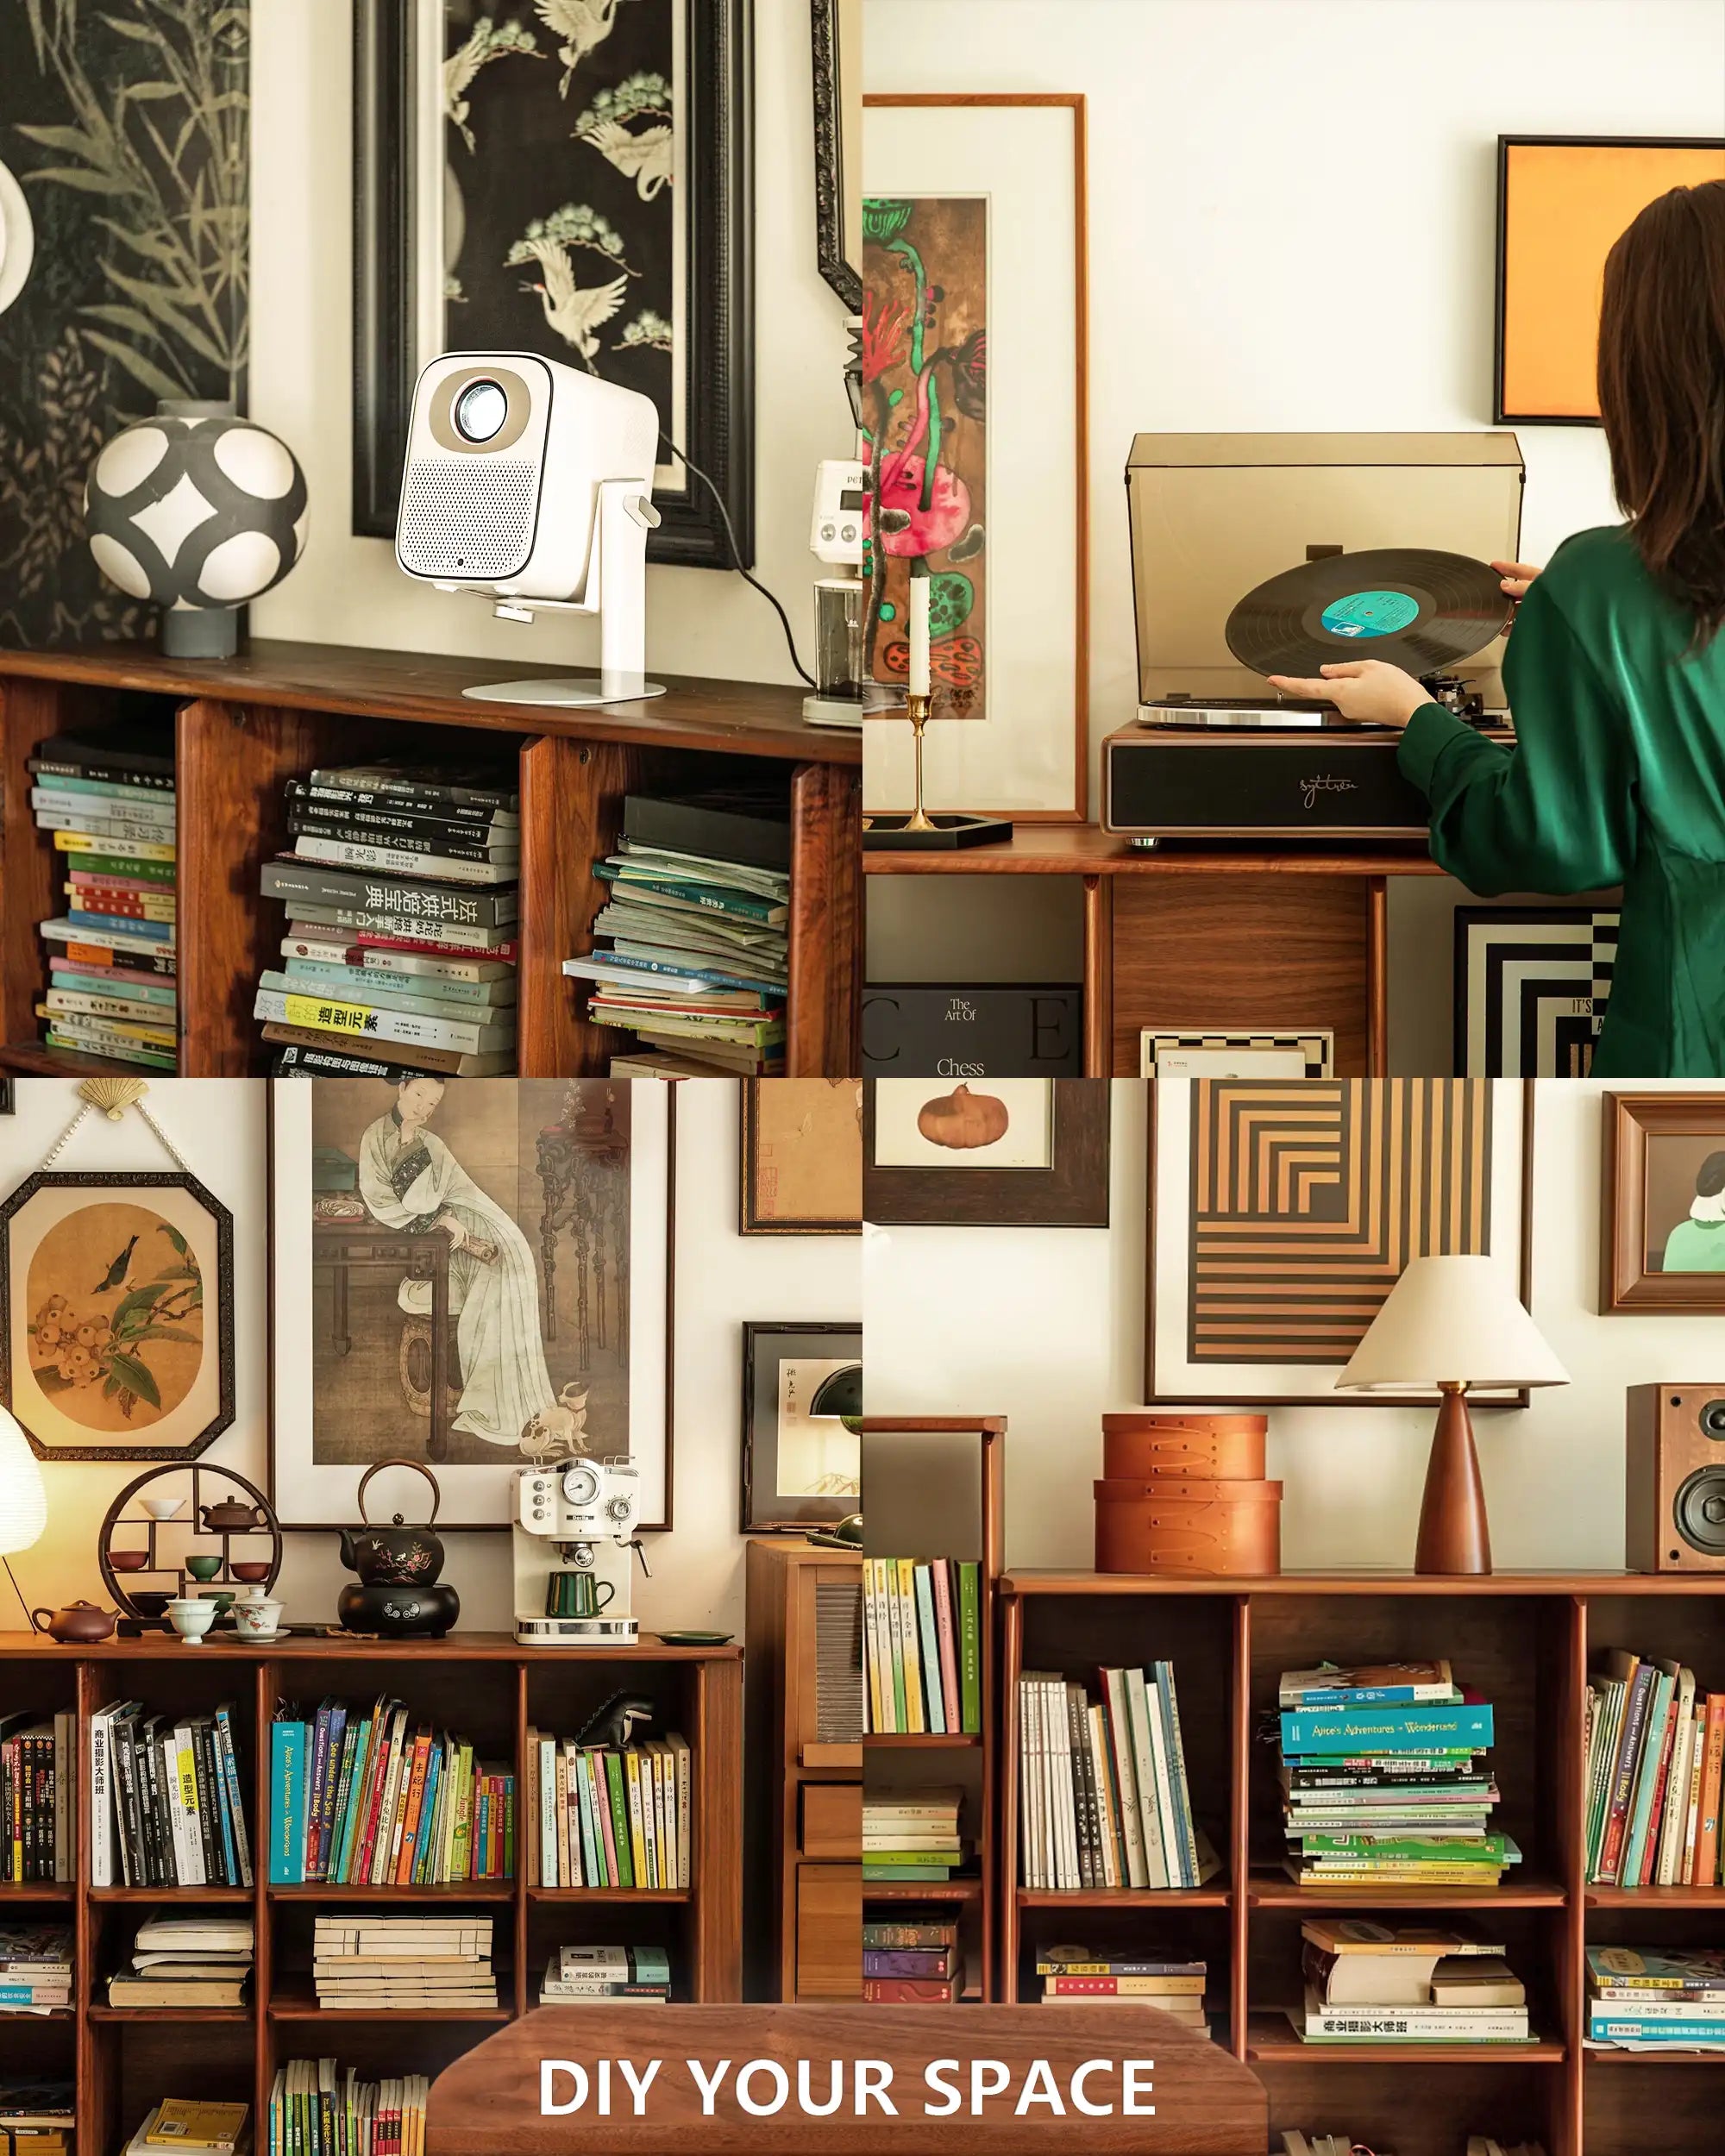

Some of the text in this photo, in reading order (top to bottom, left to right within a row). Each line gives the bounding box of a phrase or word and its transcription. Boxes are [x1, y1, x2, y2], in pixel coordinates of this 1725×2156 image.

[362, 884, 479, 924] 法式烘焙宝典
[414, 920, 443, 938] 坨坨妈
[944, 1009, 976, 1021] Art Of
[950, 998, 970, 1011] The
[1572, 999, 1592, 1013] IT'S
[1028, 998, 1070, 1060] E
[937, 1058, 985, 1076] Chess
[1631, 1688, 1647, 1727] Questions
[1312, 1725, 1341, 1737] Alice's
[1343, 1724, 1395, 1736] Adventures
[1404, 1721, 1458, 1733] Wonderland
[317, 1727, 326, 1758] Questions
[1622, 1733, 1637, 1769] Answers
[94, 1729, 104, 1795] 商业摄影大师班
[226, 1758, 237, 1776] 素描
[283, 1745, 294, 1768] Alice's
[283, 1770, 293, 1808] Adventures
[314, 1764, 323, 1790] Answers
[324, 1742, 339, 1815] See under the Sea
[411, 1763, 423, 1799] 去旅行
[1615, 1778, 1628, 1802] Body
[311, 1799, 320, 1817] Body
[380, 1798, 392, 1833] 小兔比利
[457, 1795, 468, 1821] Jungle
[283, 1816, 293, 1856] Wonderland
[1323, 2020, 1408, 2034] 商业摄影大师班
